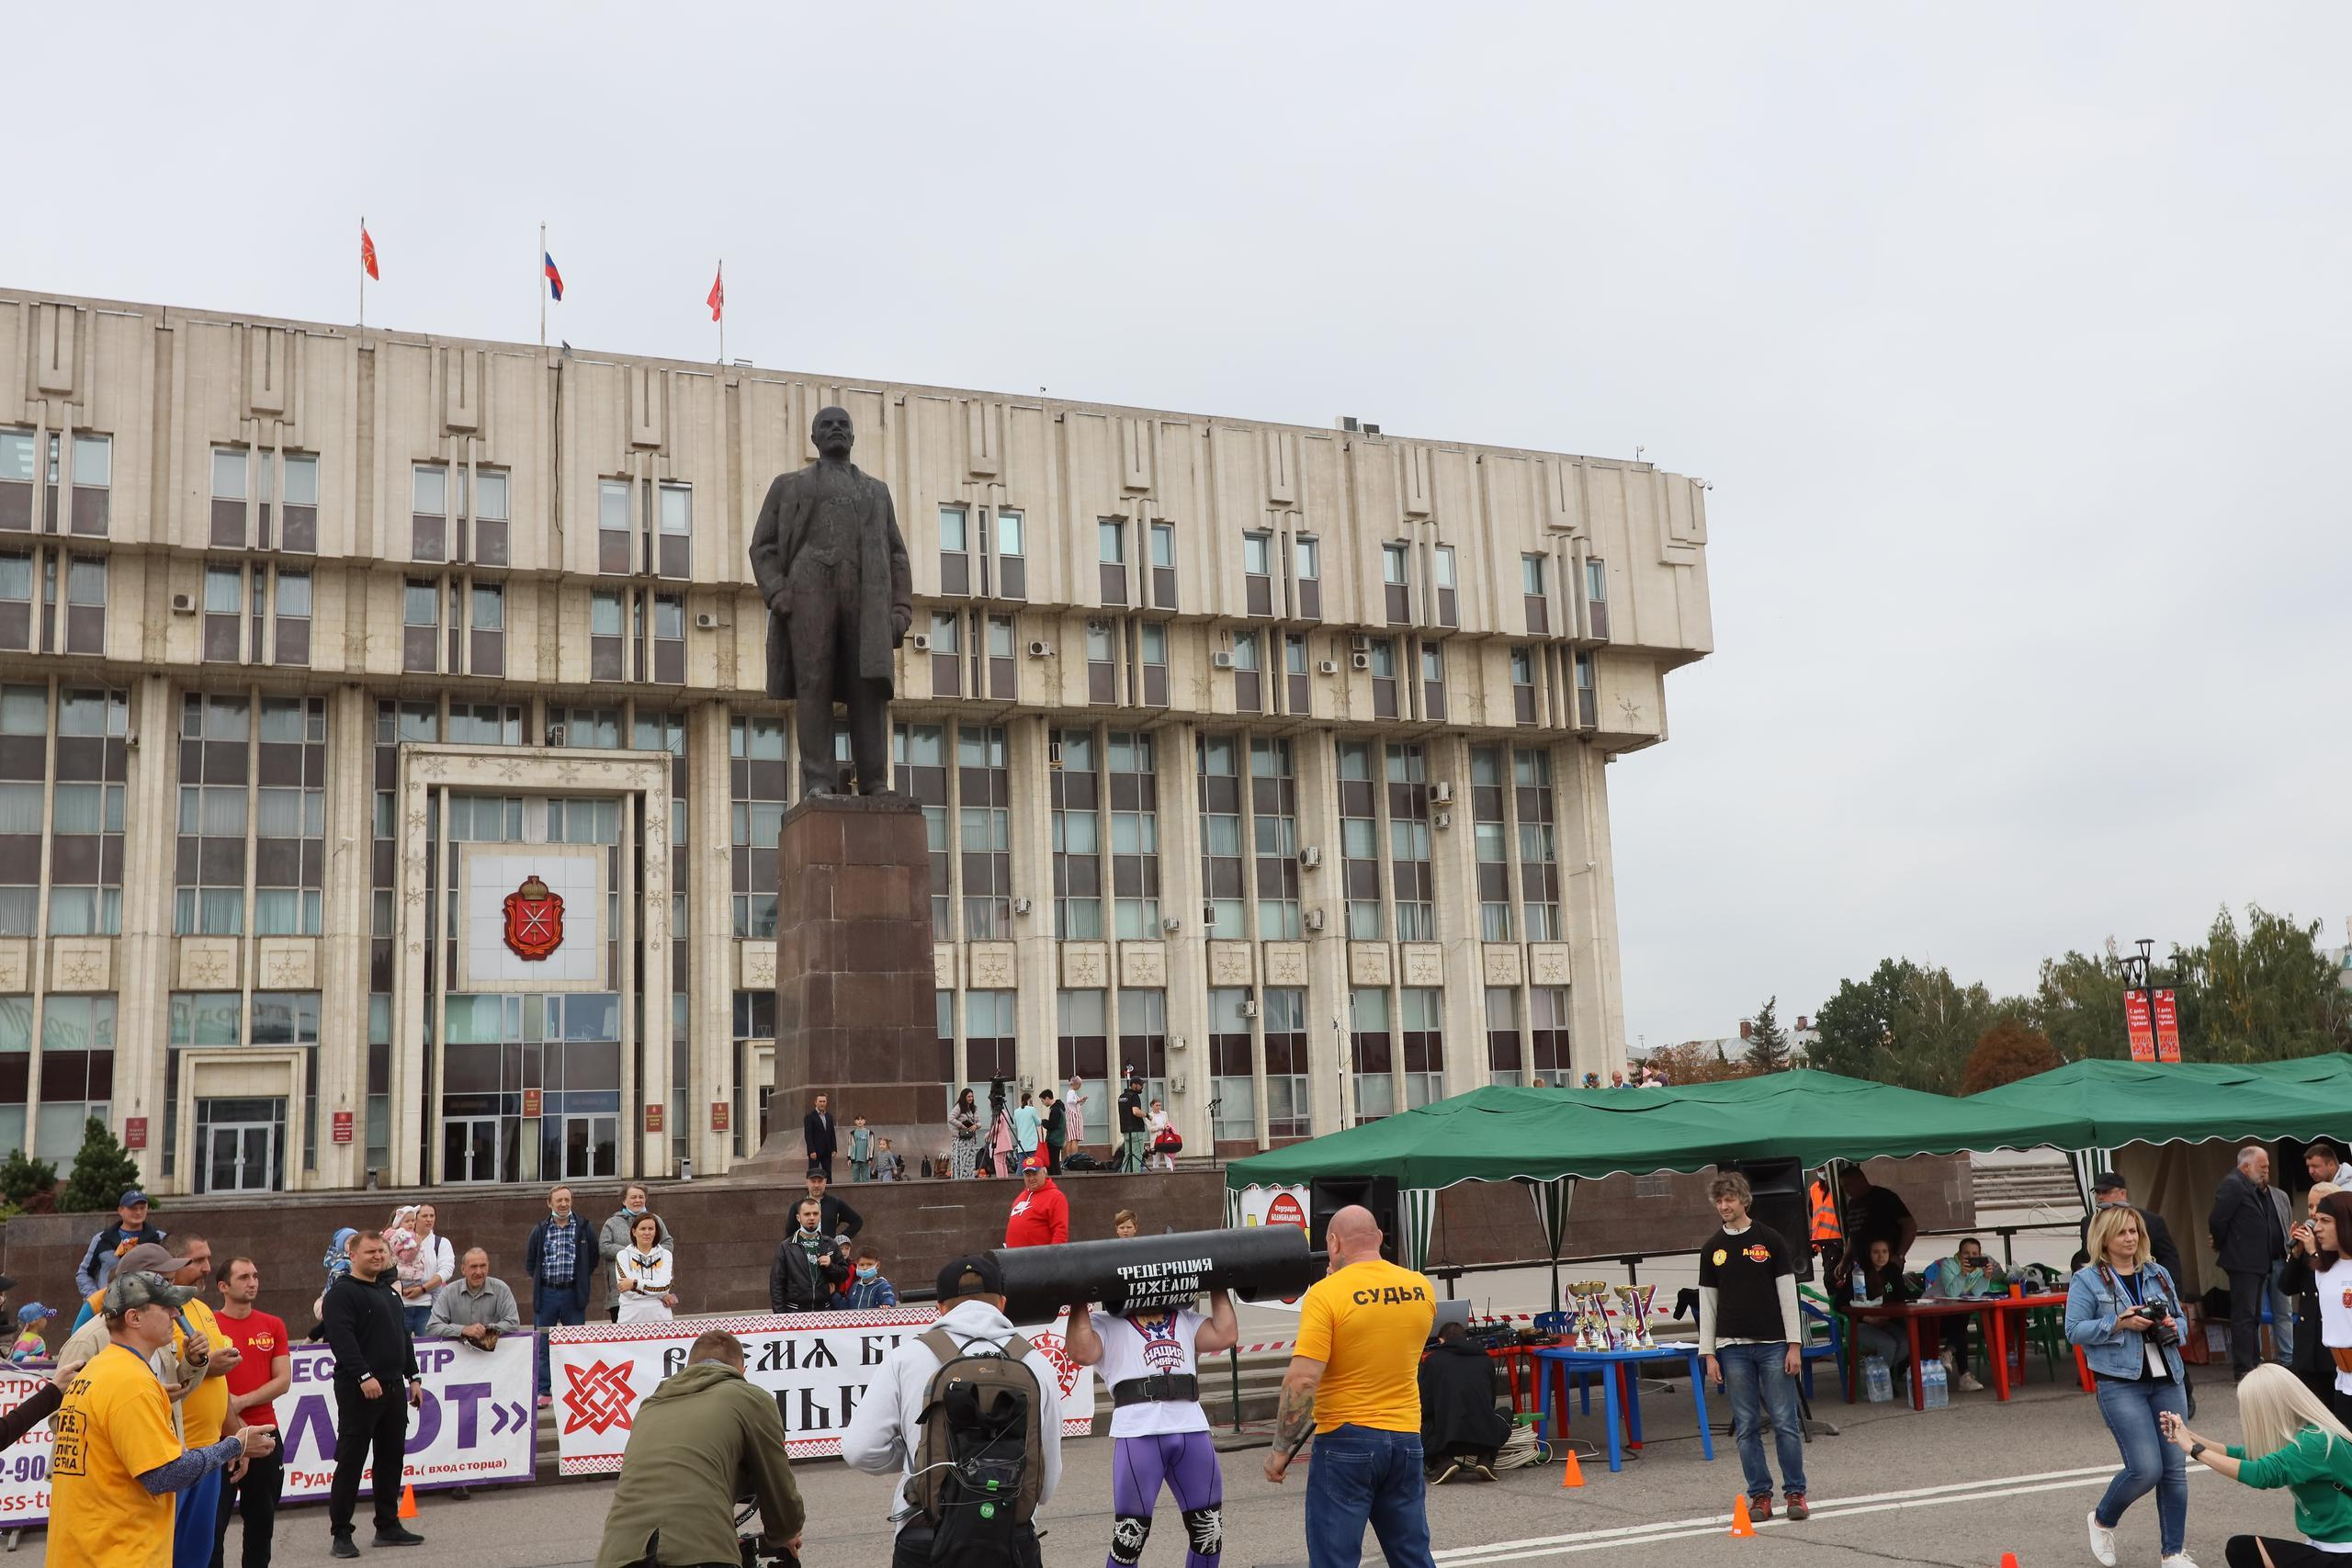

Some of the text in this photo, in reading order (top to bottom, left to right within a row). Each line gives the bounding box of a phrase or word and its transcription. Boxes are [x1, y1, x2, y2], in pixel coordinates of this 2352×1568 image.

[1117, 1258, 1213, 1280] ФЕДЕРАЦИЯ
[1128, 1274, 1199, 1296] ТЯЖЁЛОЙ
[1124, 1292, 1199, 1309] АТЛЕТИКИ
[1352, 1286, 1426, 1305] СУДЬЯ
[1144, 1346, 1184, 1364] НАЦИЯ
[1154, 1357, 1180, 1367] МИРА
[467, 1458, 507, 1471] торца)
